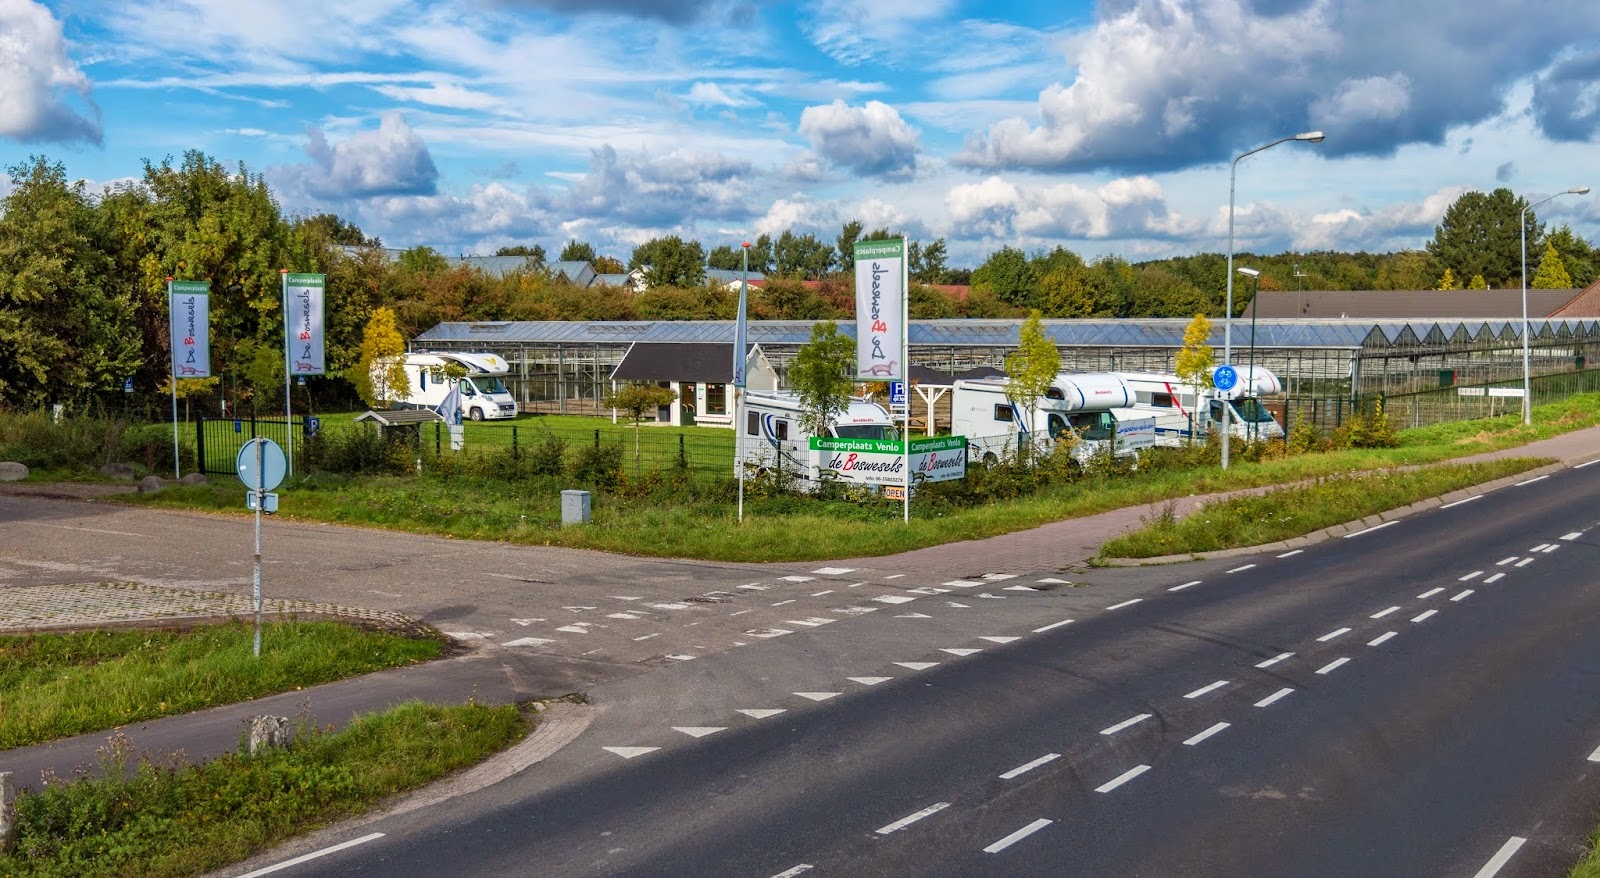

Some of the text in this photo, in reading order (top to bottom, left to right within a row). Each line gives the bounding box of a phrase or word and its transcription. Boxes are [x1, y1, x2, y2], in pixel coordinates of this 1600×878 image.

[288, 277, 323, 285] Camperplaats
[182, 296, 195, 364] De Boswesels
[297, 289, 311, 360] De Boswesels
[816, 439, 900, 452] Camperplaats Venlo
[911, 438, 961, 452] Camperplaats Venlo
[828, 452, 904, 474] de Boswesels
[886, 488, 905, 498] OPEN
